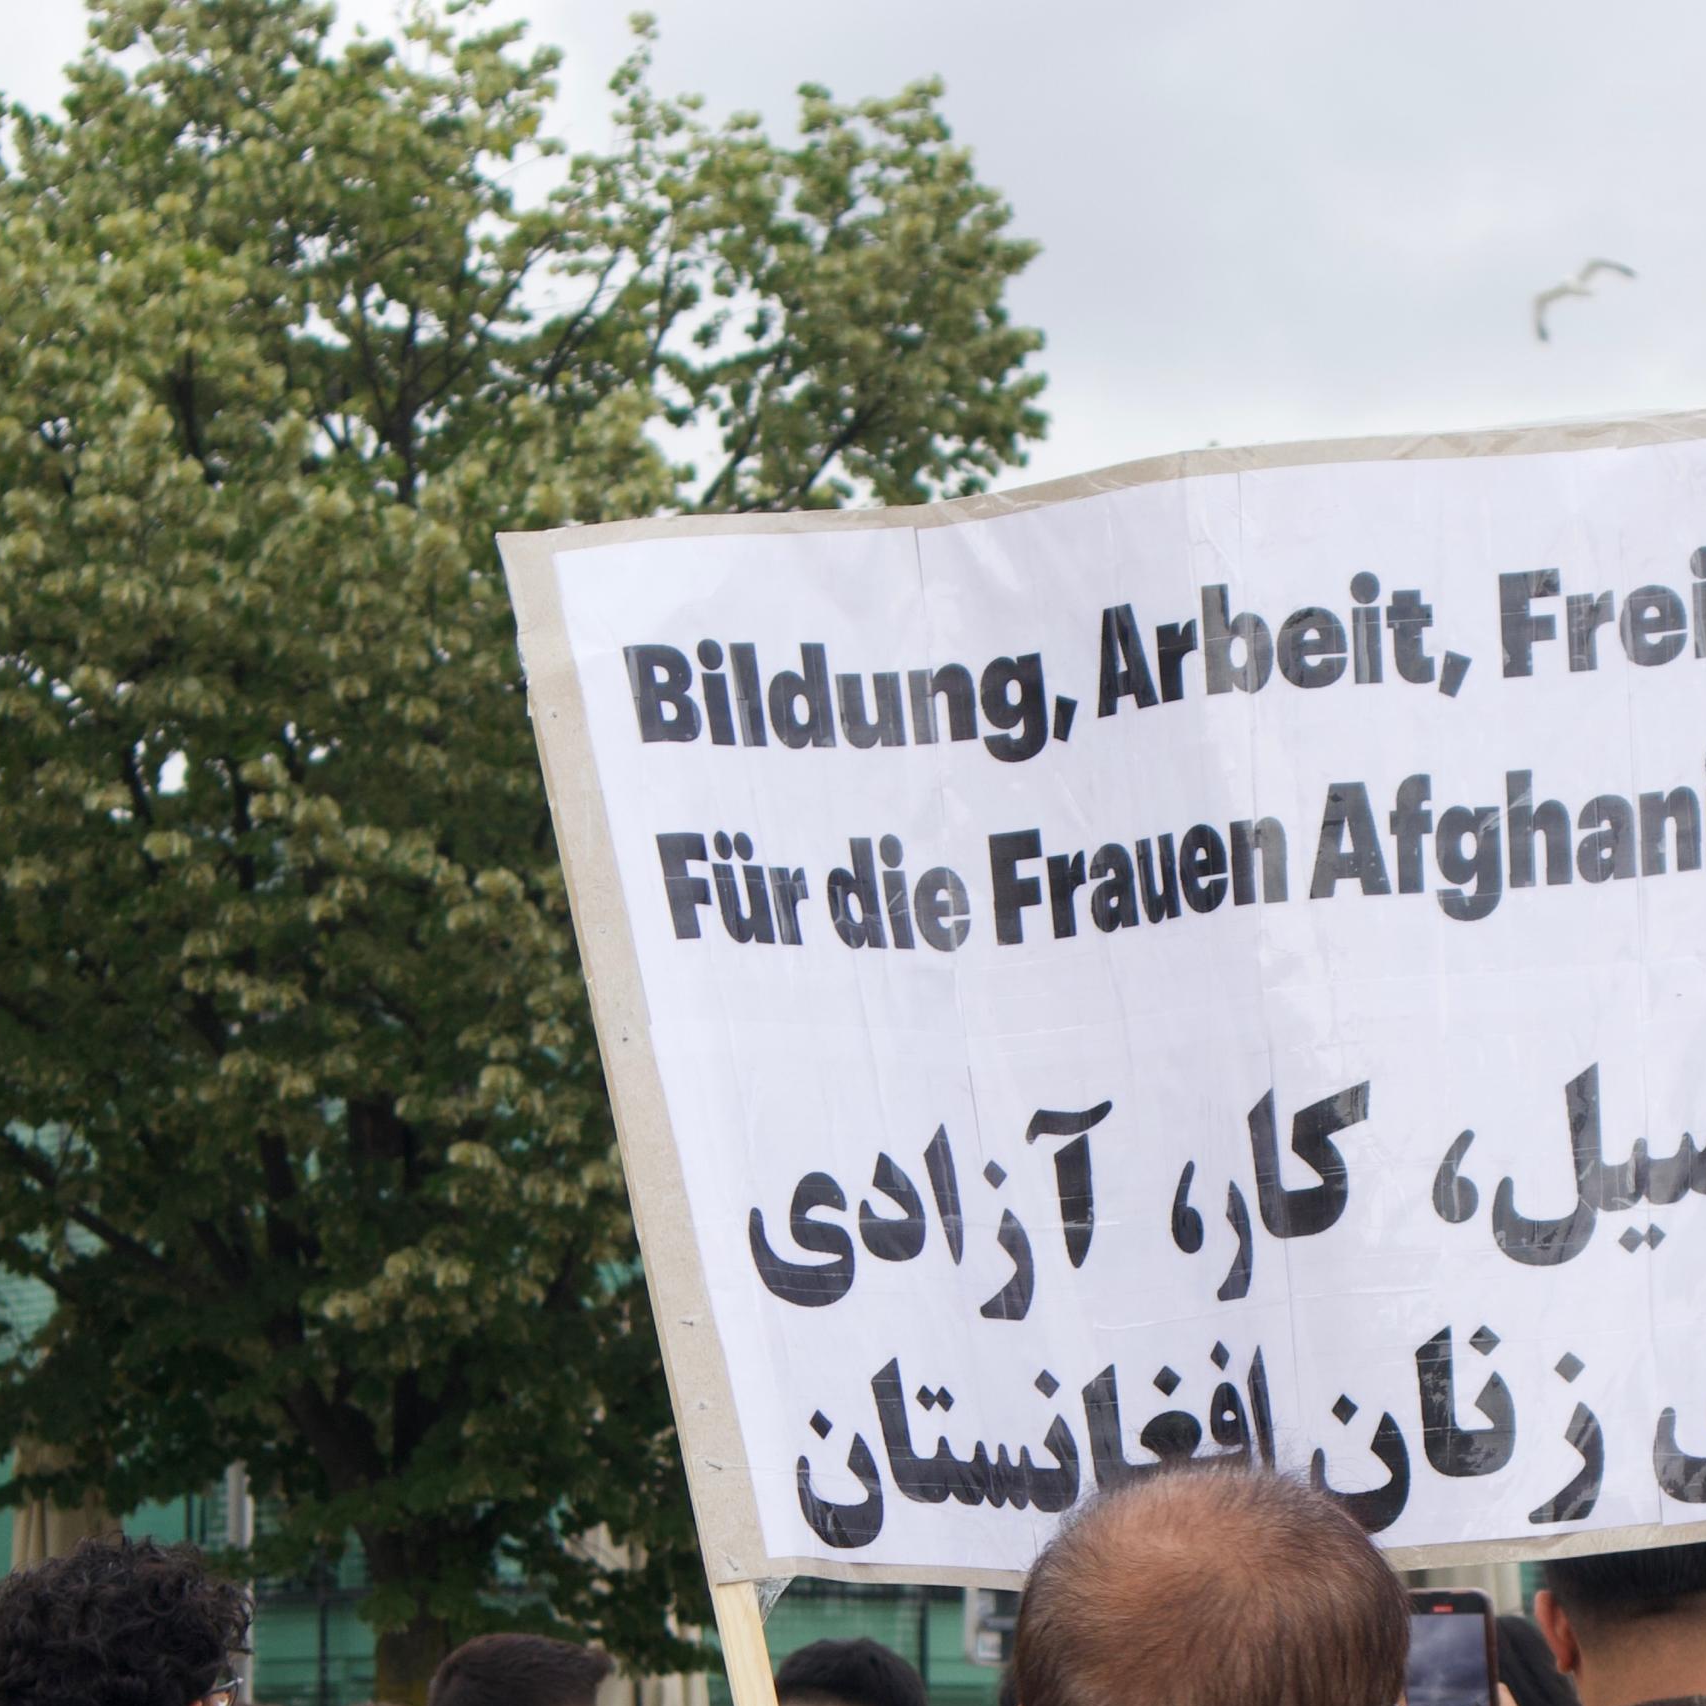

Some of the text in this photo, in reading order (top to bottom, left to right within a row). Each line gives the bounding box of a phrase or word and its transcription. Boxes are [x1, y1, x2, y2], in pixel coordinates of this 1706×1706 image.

[623, 642, 1079, 763] Bildung,
[1097, 571, 1471, 718] Arbeit,
[655, 831, 807, 948] Für
[826, 836, 971, 951] die
[988, 814, 1289, 946] Frauen
[747, 1100, 1113, 1321] آزادی
[1170, 1081, 1371, 1304] کار،
[796, 1341, 1276, 1549] افغانستان
[1309, 1325, 1605, 1533] زنان
